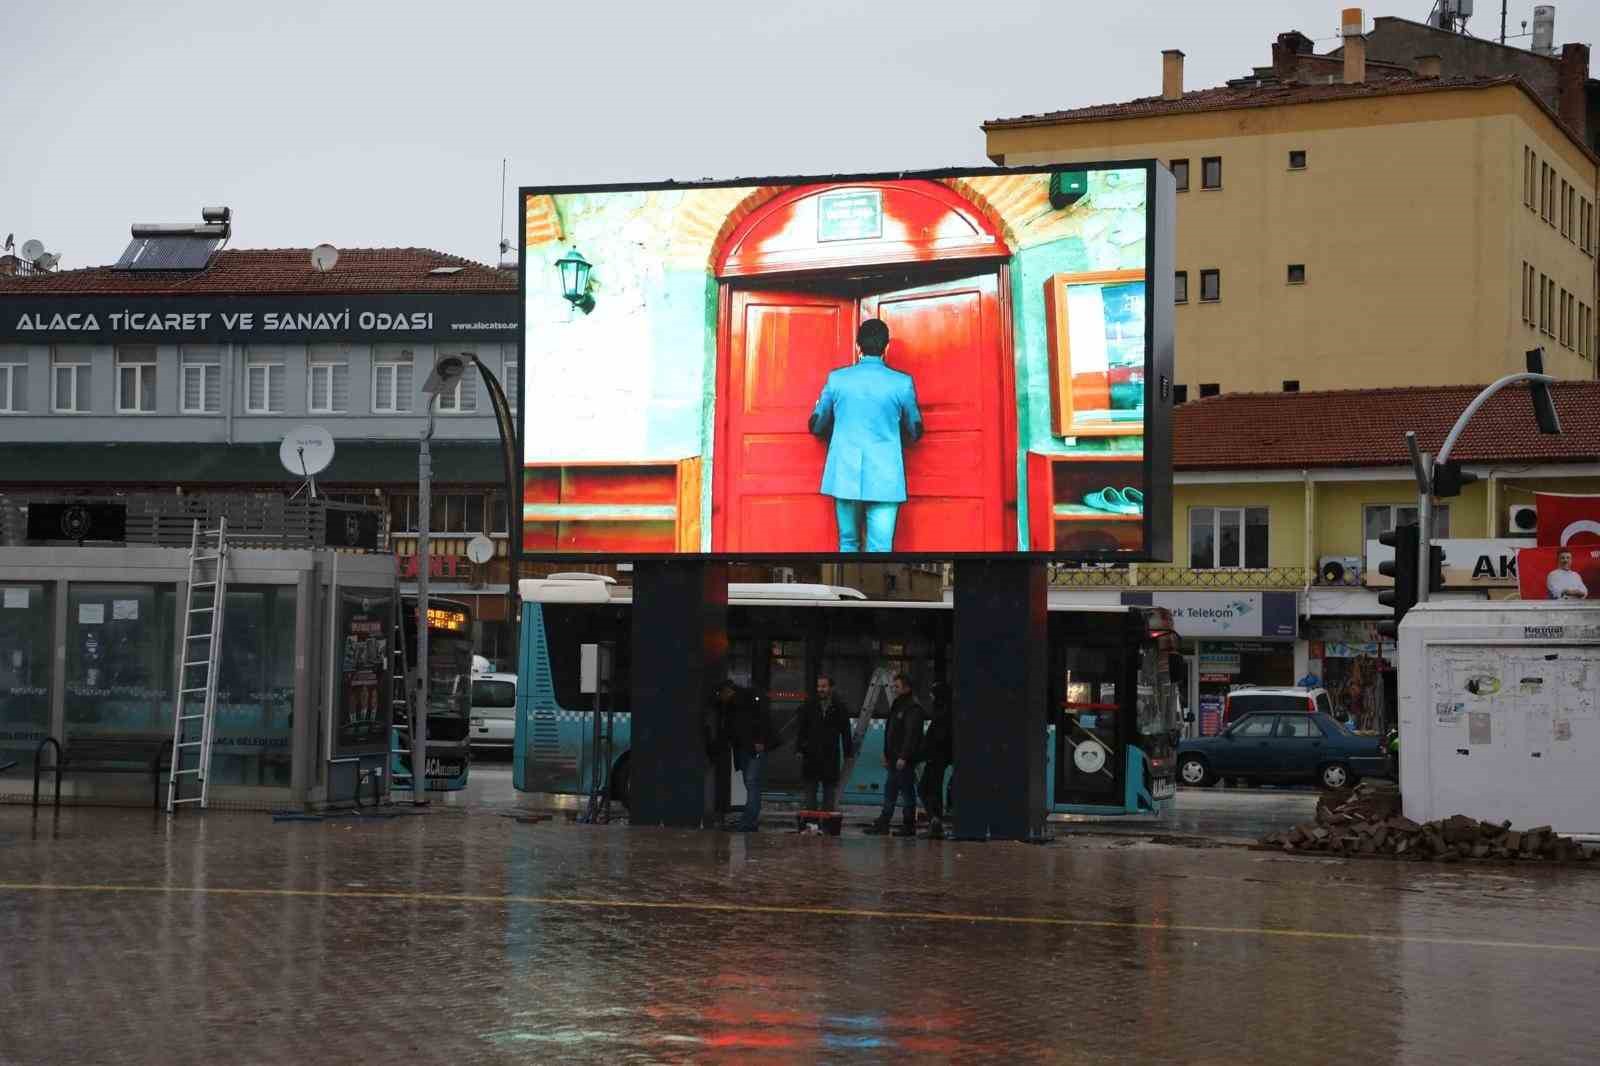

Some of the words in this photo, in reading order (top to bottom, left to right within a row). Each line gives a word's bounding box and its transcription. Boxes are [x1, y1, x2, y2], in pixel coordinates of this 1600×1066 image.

[16, 313, 100, 330] ALACA
[108, 309, 211, 330] TİCARET
[220, 313, 254, 330] VE
[263, 308, 350, 330] SANAYİ
[358, 311, 433, 330] ODASI
[1187, 607, 1234, 619] Telekom
